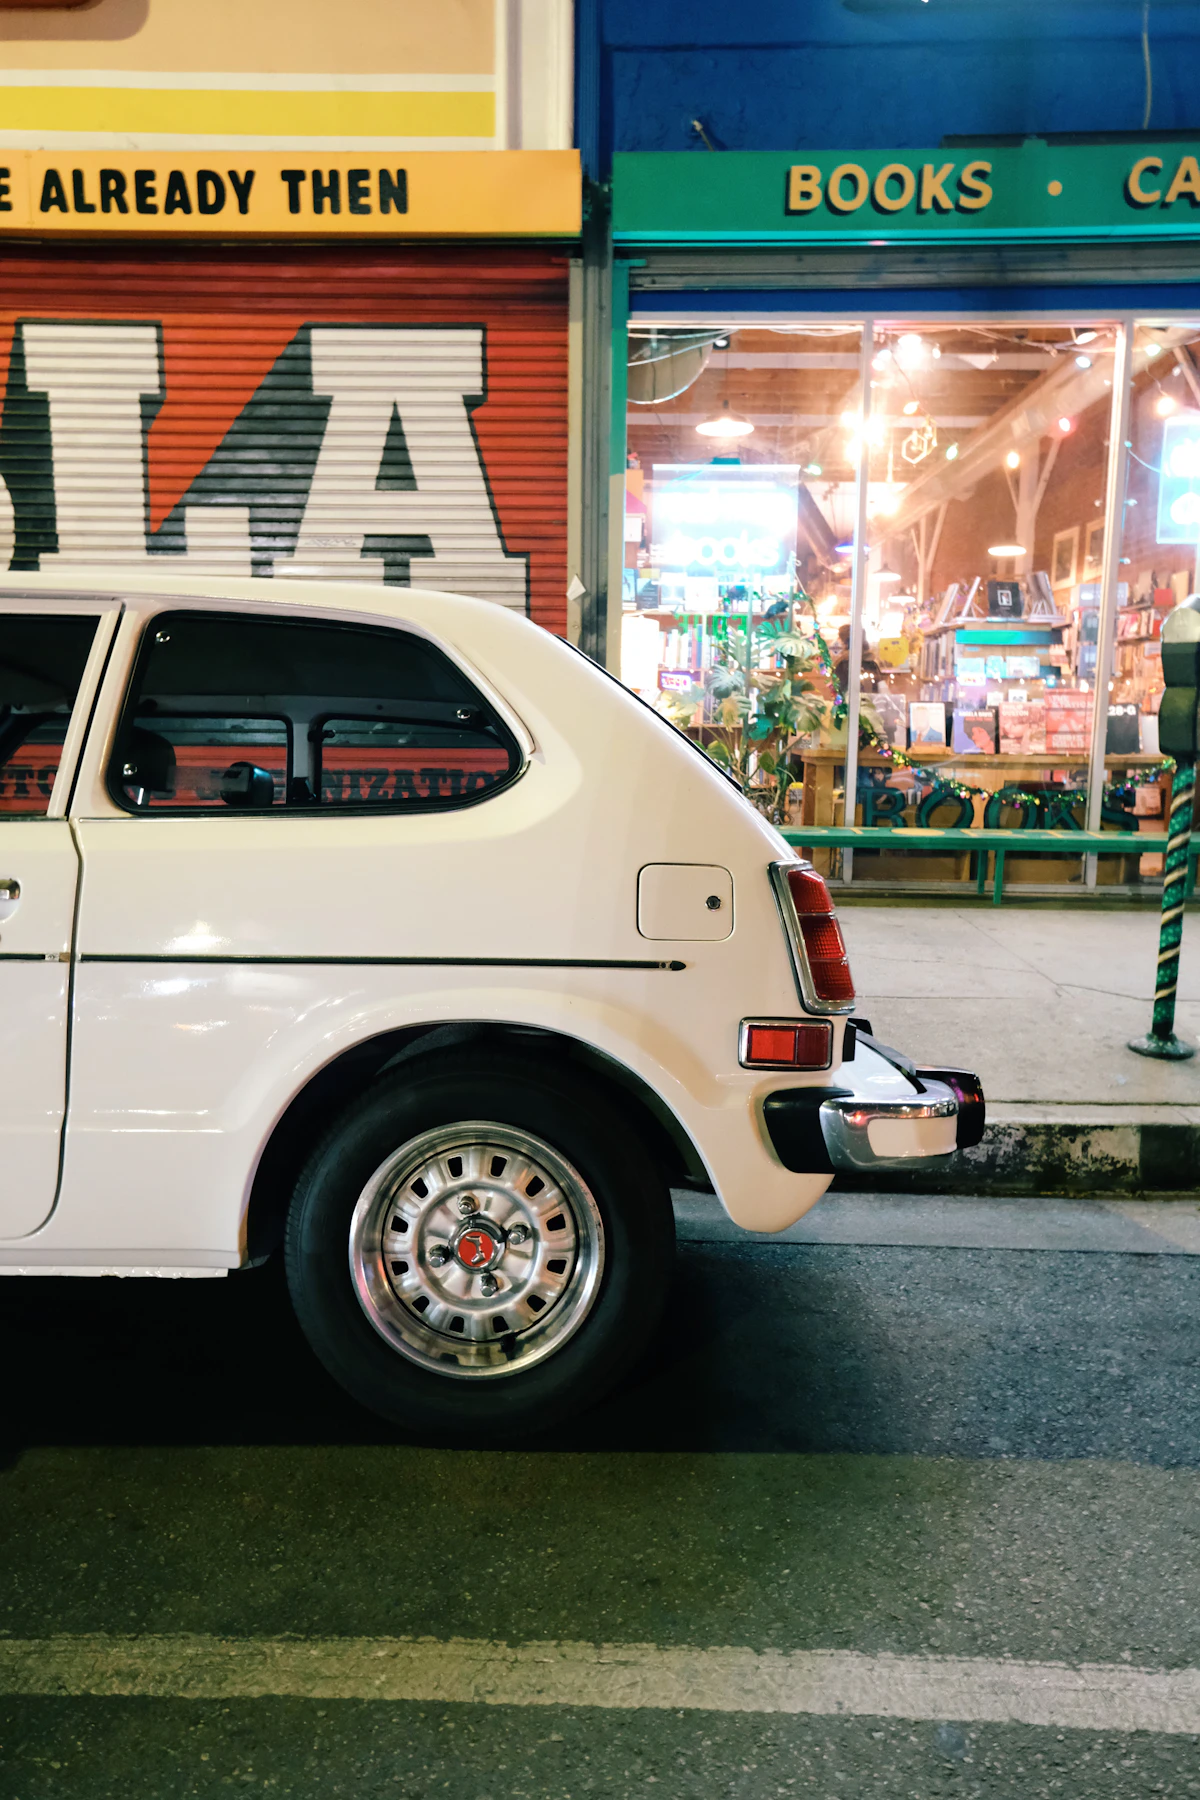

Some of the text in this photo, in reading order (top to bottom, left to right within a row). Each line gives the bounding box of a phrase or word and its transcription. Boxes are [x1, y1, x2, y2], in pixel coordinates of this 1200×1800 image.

[40, 168, 256, 215] ALREADY
[280, 168, 409, 215] THEN
[787, 156, 1200, 213] BOOKS CA
